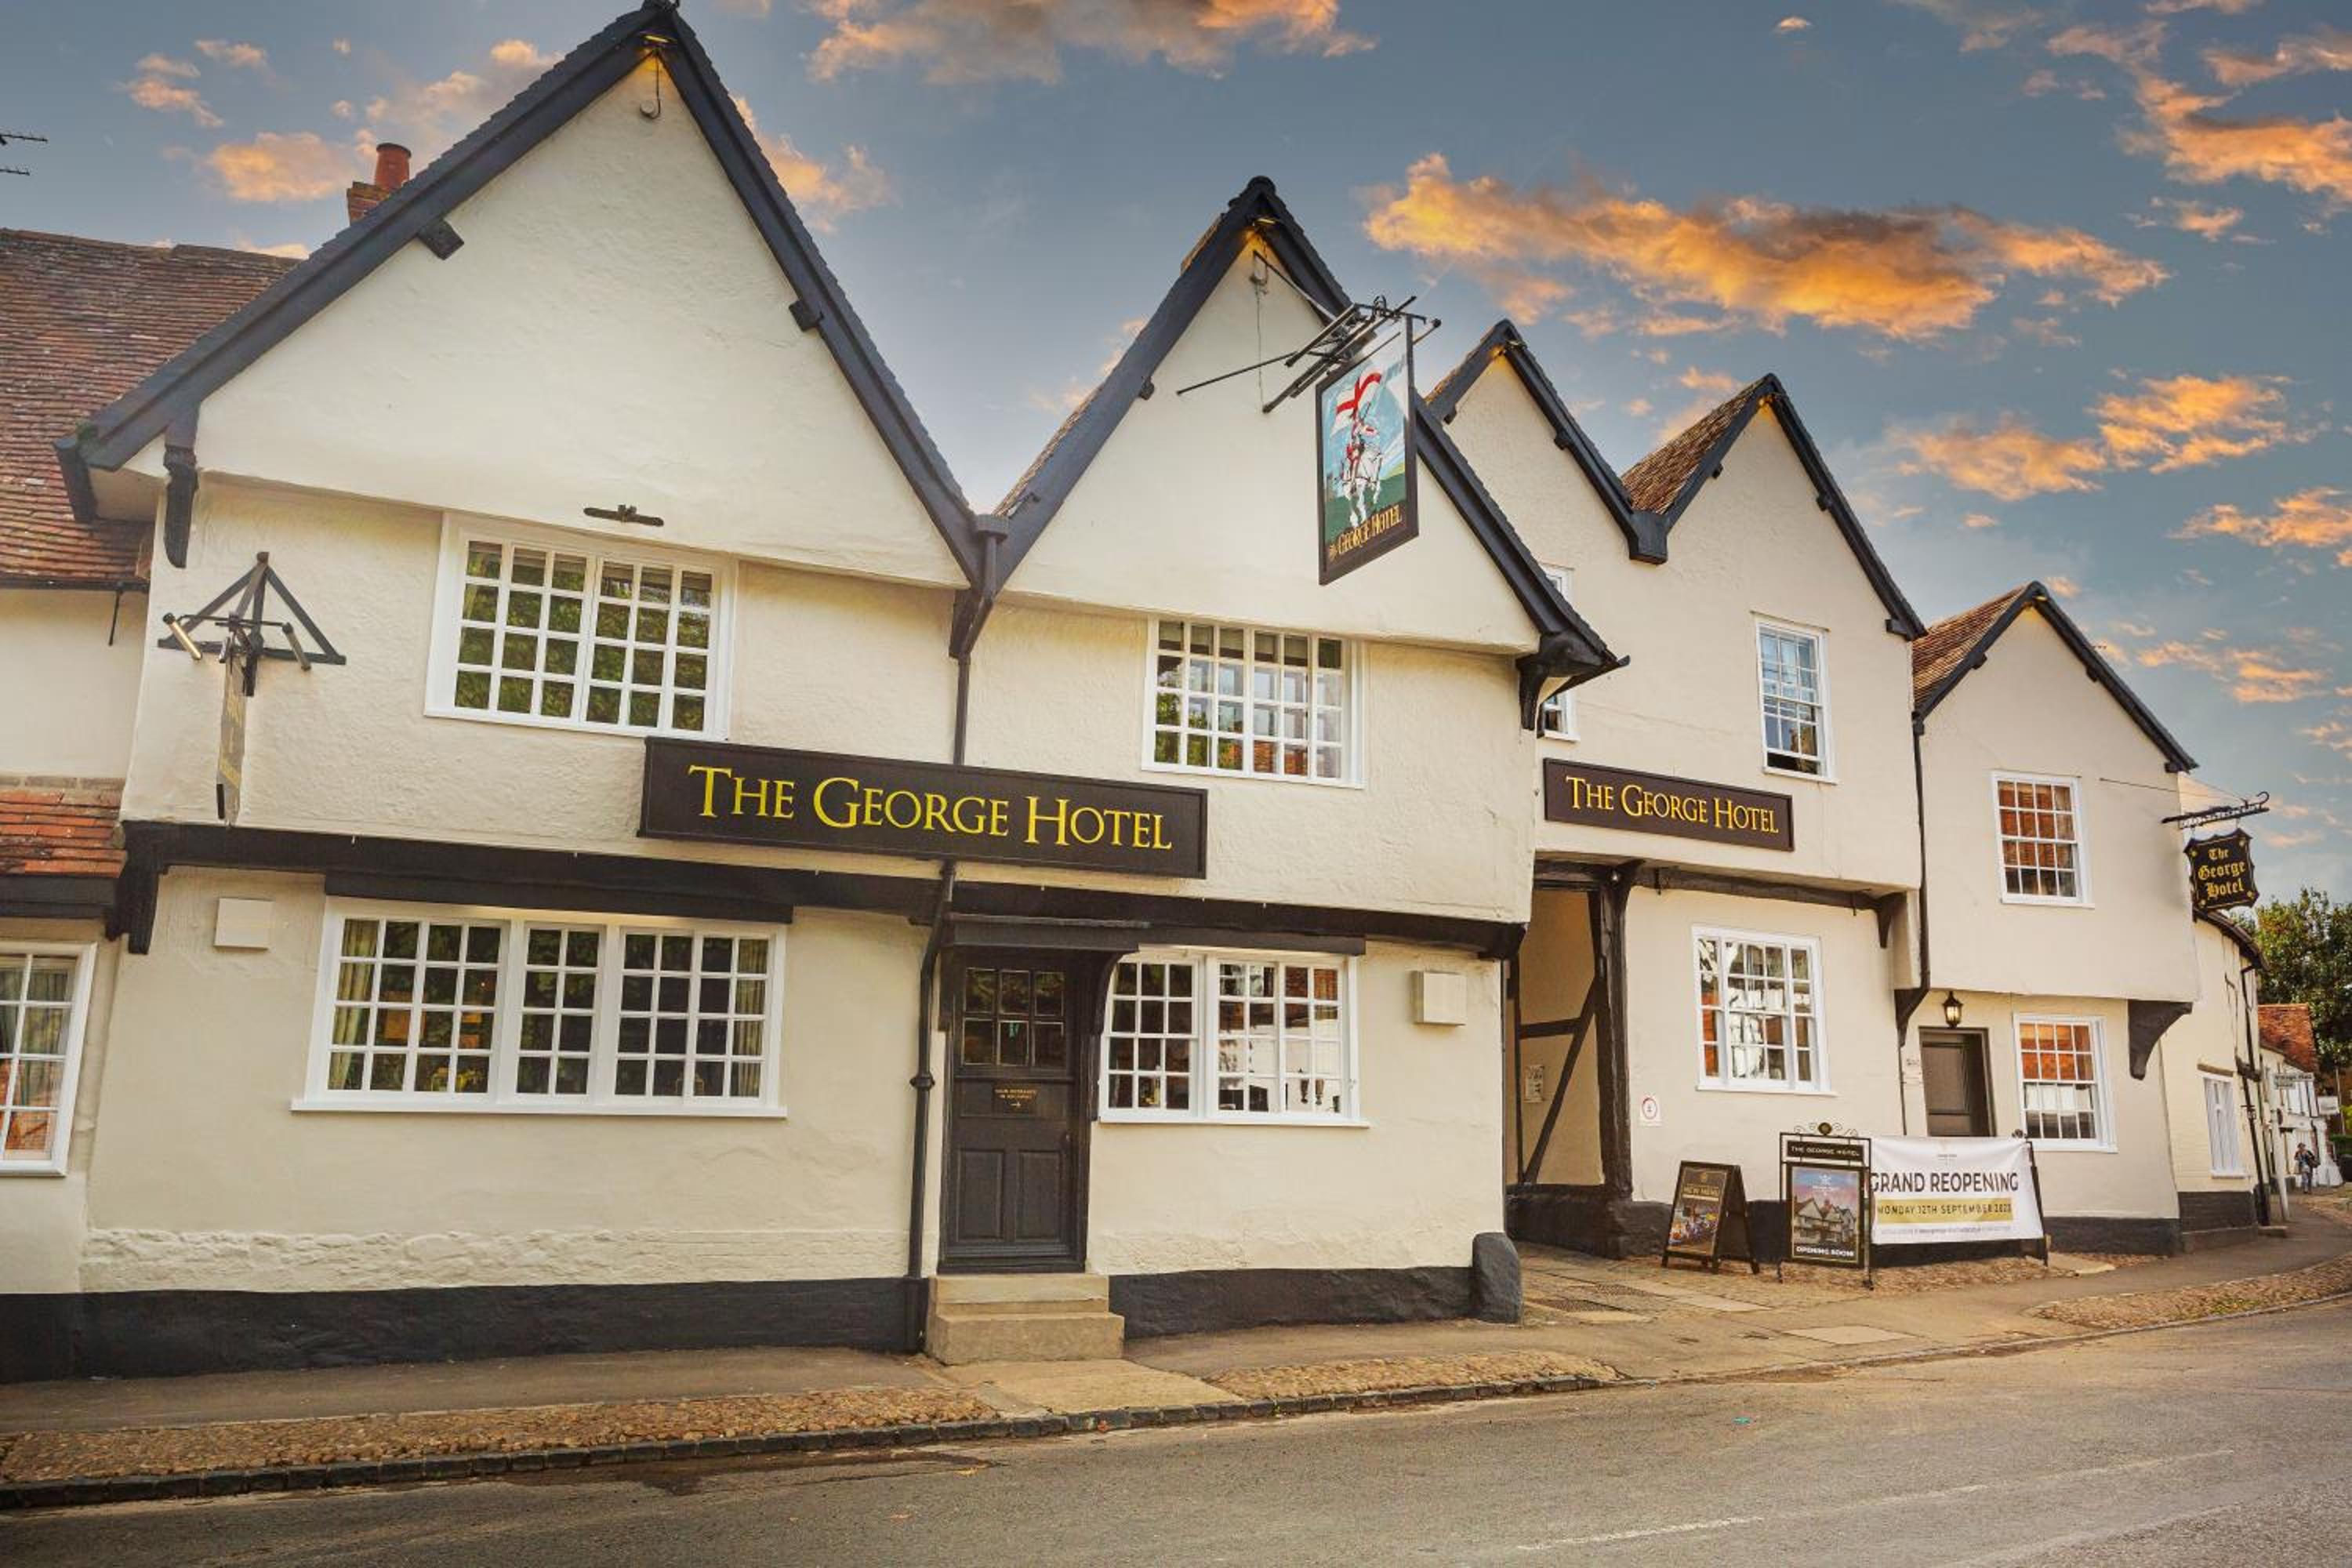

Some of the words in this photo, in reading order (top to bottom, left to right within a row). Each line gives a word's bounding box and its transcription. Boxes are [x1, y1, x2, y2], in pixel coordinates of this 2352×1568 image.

[1371, 504, 1403, 537] HOTEL
[688, 764, 795, 818] THE
[813, 777, 1009, 837] GEORGE
[1025, 796, 1172, 851] HOTEL
[1566, 775, 1614, 810] THE
[1620, 784, 1708, 824] GEORGE
[1713, 797, 1779, 833] HOTEL
[2208, 848, 2230, 861] The
[2198, 862, 2246, 880] George
[2206, 878, 2245, 900] Hotel
[1871, 1172, 1925, 1192] GRAND
[1930, 1172, 2020, 1192] REOPENING
[1878, 1203, 1915, 1214] MONDAY
[1940, 1203, 1992, 1214] SEPTEMBER
